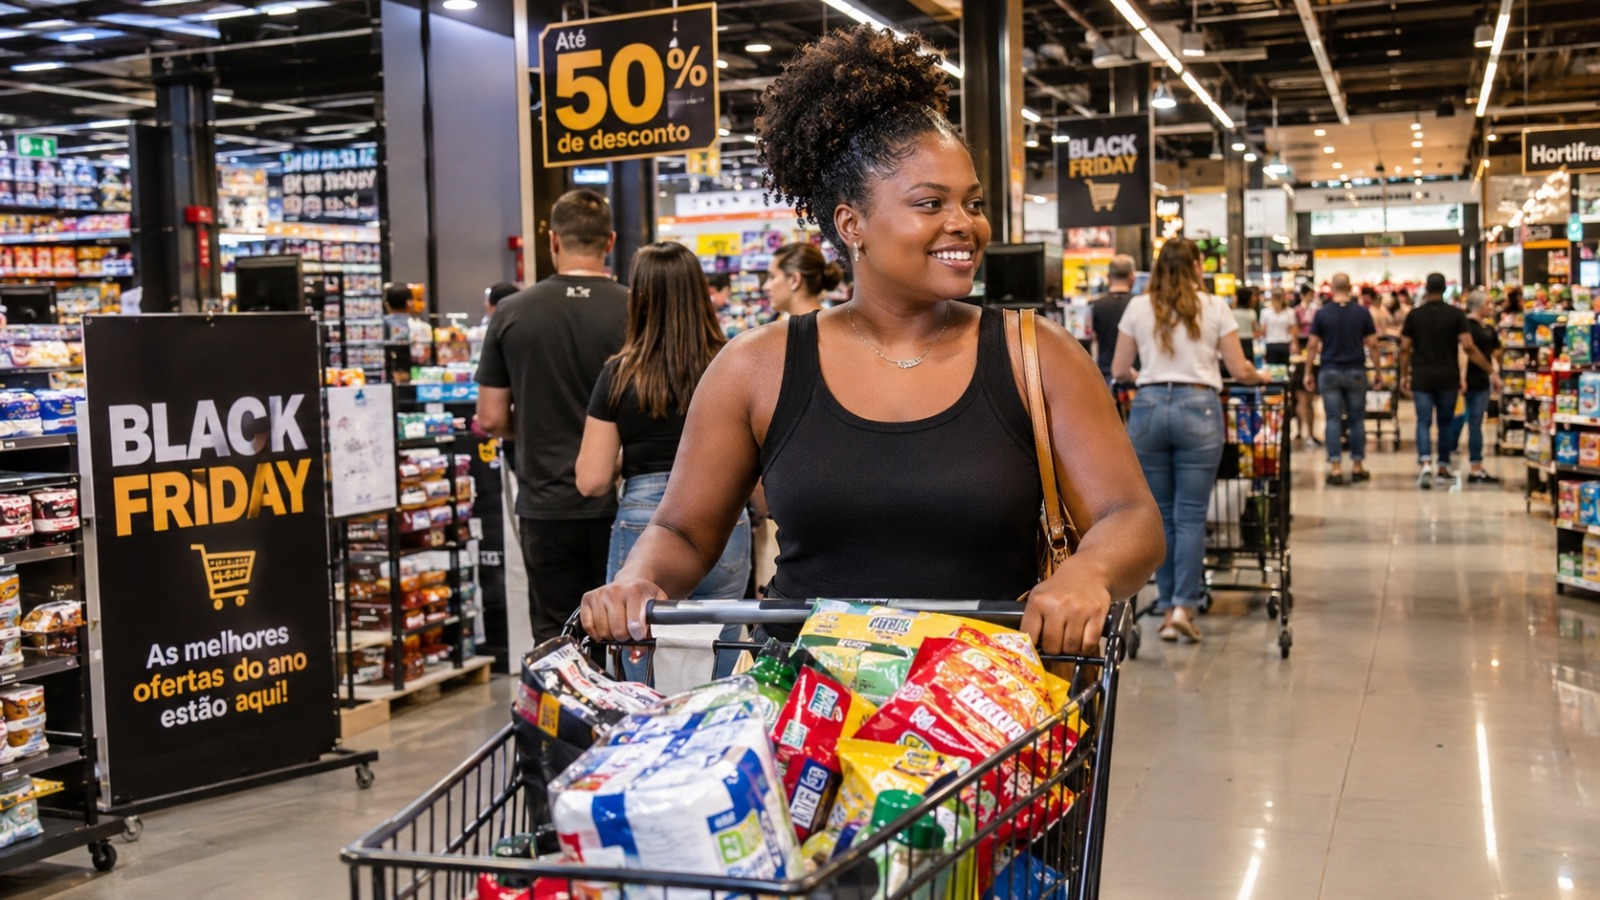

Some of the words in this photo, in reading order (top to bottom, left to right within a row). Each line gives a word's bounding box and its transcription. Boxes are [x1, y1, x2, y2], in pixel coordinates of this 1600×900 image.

[556, 29, 586, 51] Até
[555, 43, 707, 131] 50%
[557, 132, 585, 153] de
[589, 123, 690, 150] desconto
[1068, 133, 1138, 159] BLACK
[1069, 155, 1138, 178] FRIDAY
[108, 394, 309, 467] BLACK
[113, 458, 312, 537] FRIDAY
[146, 643, 179, 669] As
[185, 626, 289, 661] melhores
[133, 668, 225, 702] ofertas
[233, 657, 263, 682] do
[268, 652, 307, 676] ano
[160, 695, 227, 728] estão
[235, 679, 288, 713] aqui!
